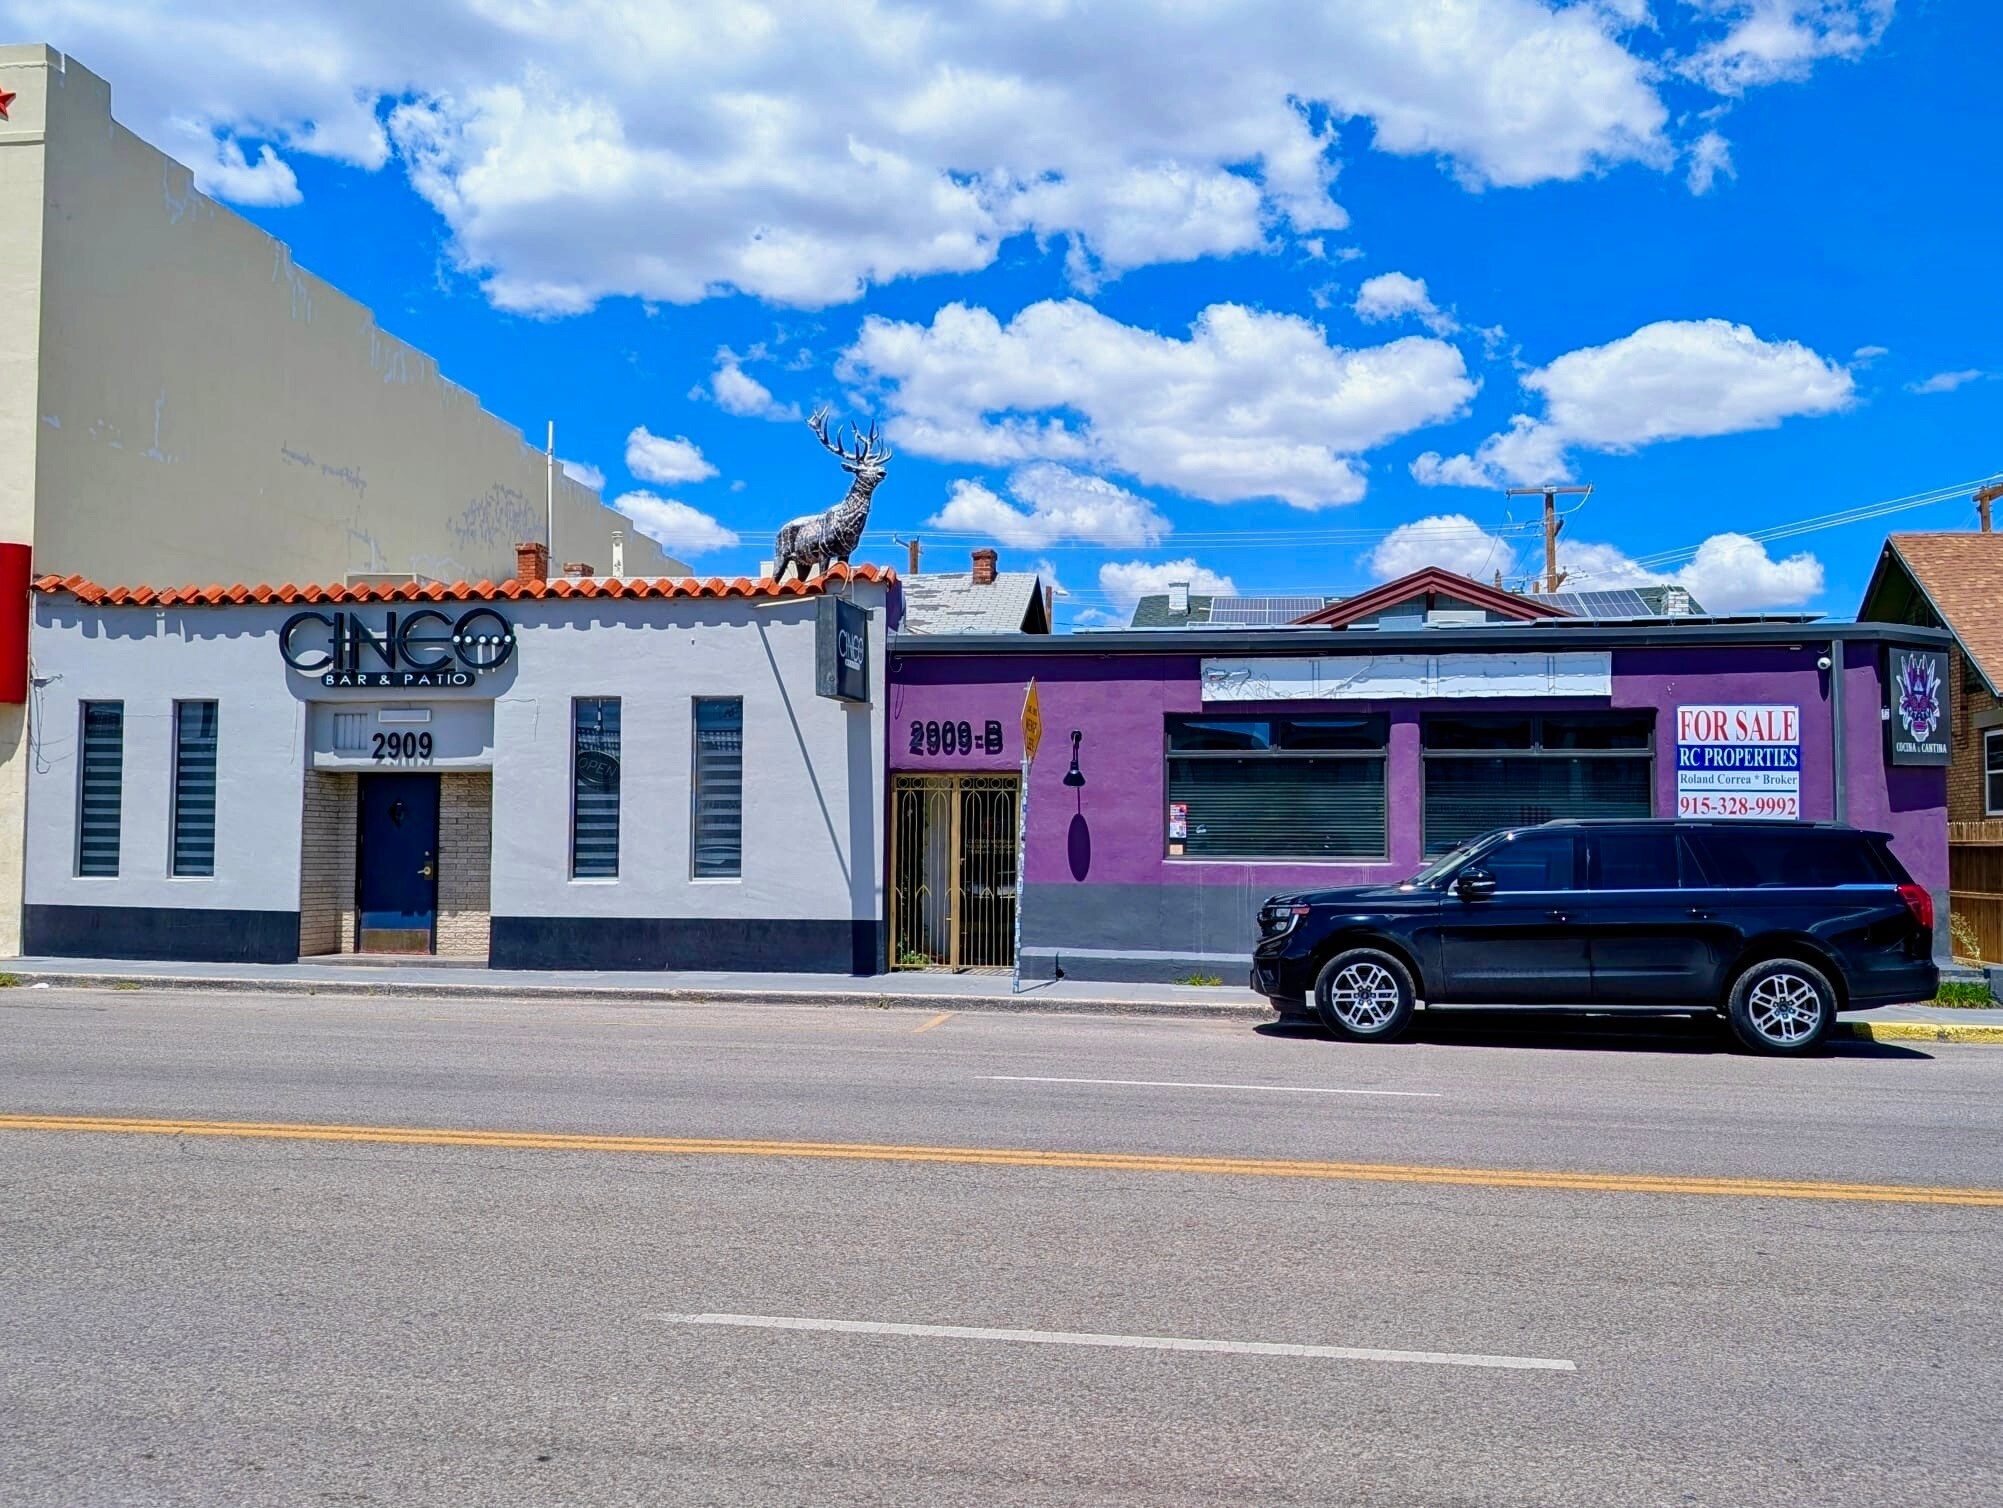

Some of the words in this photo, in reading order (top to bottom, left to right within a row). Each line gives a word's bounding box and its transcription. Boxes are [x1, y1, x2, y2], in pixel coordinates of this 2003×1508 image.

[279, 608, 516, 670] CINCO
[838, 629, 865, 665] CINCO
[326, 674, 367, 685] BAR
[379, 674, 391, 685] &
[404, 673, 467, 685] PATIO
[909, 720, 1003, 751] 2909-B
[1680, 710, 1729, 742] FOR
[1736, 709, 1797, 742] SALE
[372, 731, 433, 760] 2909
[1896, 742, 1916, 753] COCINA
[1921, 743, 1947, 753] CANTINA
[577, 757, 618, 777] OPEN
[1680, 747, 1701, 767] RC
[1704, 747, 1798, 767] PROPERTIES
[1680, 773, 1714, 785] Roland
[1717, 773, 1751, 785] Correa
[1763, 774, 1798, 785] Broker
[1680, 796, 1796, 815] 915-328-9992
